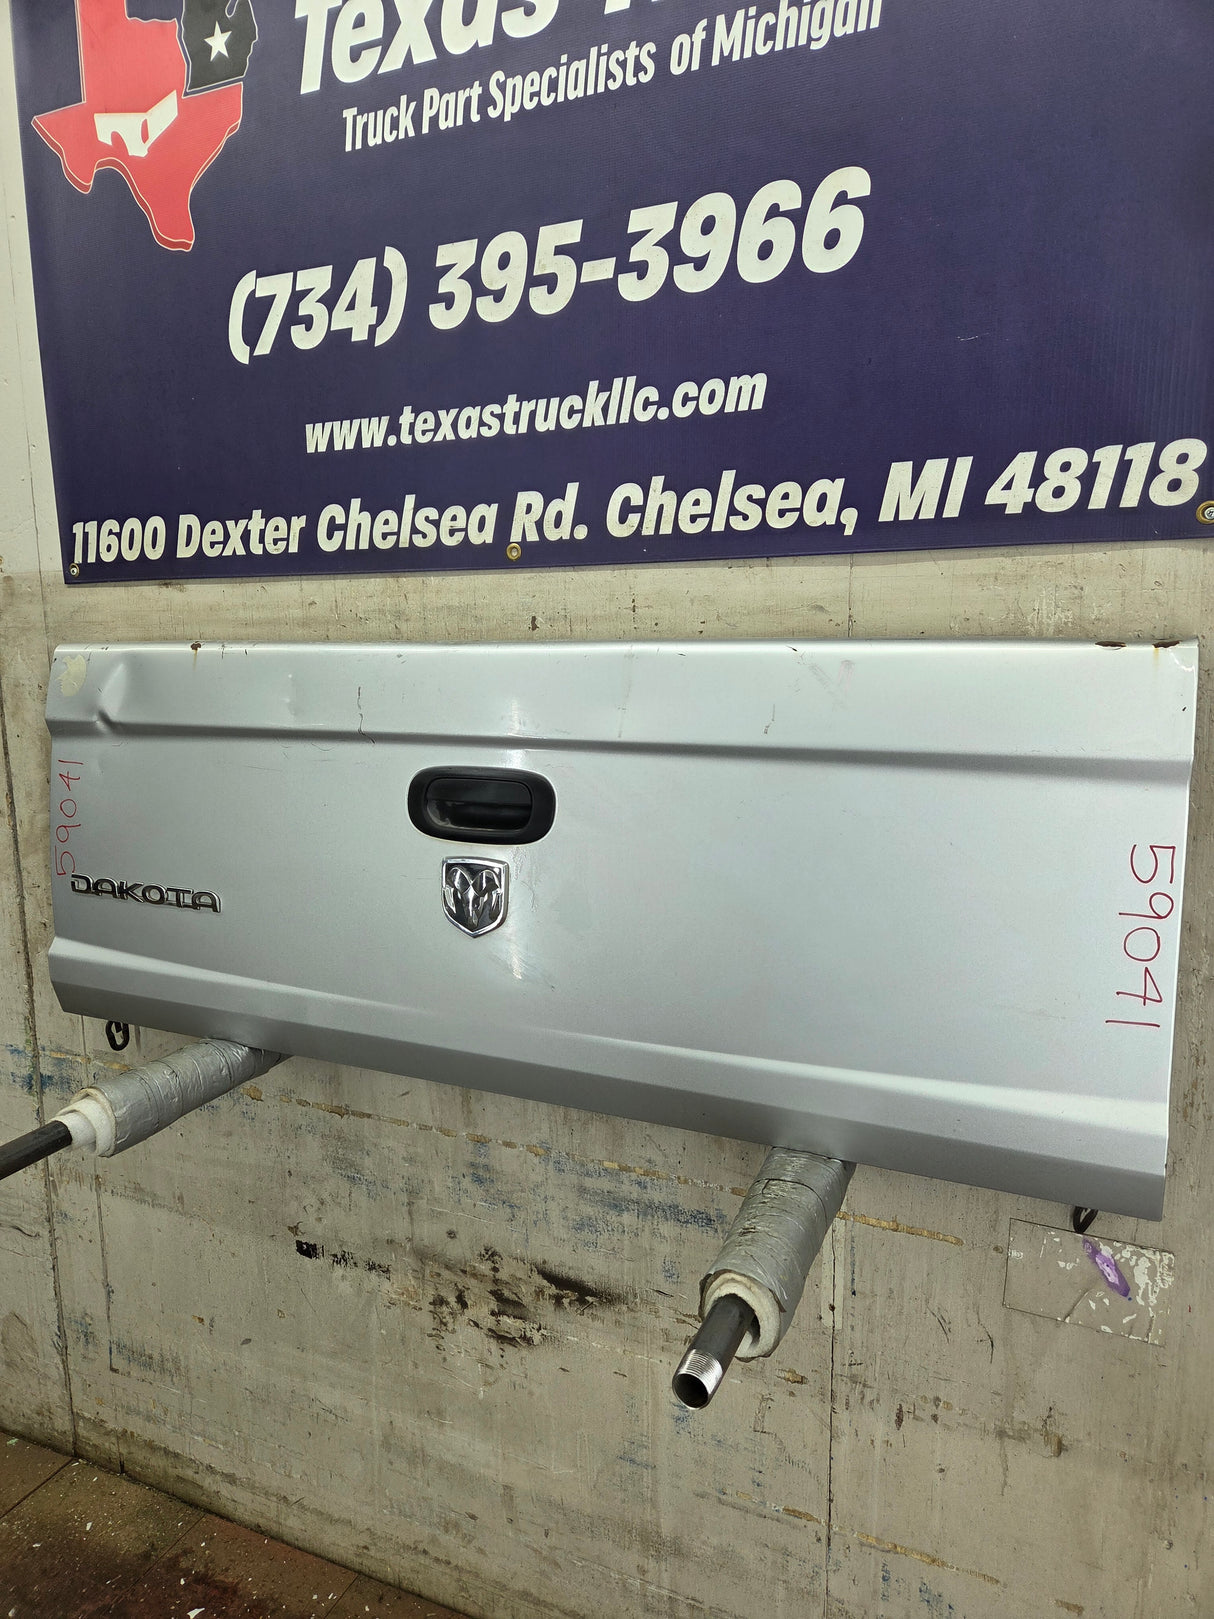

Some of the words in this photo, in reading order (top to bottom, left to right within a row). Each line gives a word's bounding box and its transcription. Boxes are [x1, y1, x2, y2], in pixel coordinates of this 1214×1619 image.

[342, 94, 417, 153] Truck
[421, 80, 483, 135] Part
[487, 40, 657, 123] Specialists
[669, 17, 708, 76] of
[711, 0, 883, 67] Michigan
[228, 245, 408, 365] (734)
[428, 166, 872, 330] 395-3966
[305, 372, 768, 454] www.texastruckllc.com
[72, 515, 166, 564] 11600
[176, 509, 307, 558] Dexter
[316, 493, 499, 552] Chelsea
[509, 481, 588, 543] Rd.
[606, 469, 859, 538] Chelsea,
[878, 455, 974, 522] MI
[984, 438, 1208, 514] 48118
[54, 759, 85, 877] 59041
[70, 873, 222, 913] DAKOTA
[1105, 844, 1176, 1028] 59041
